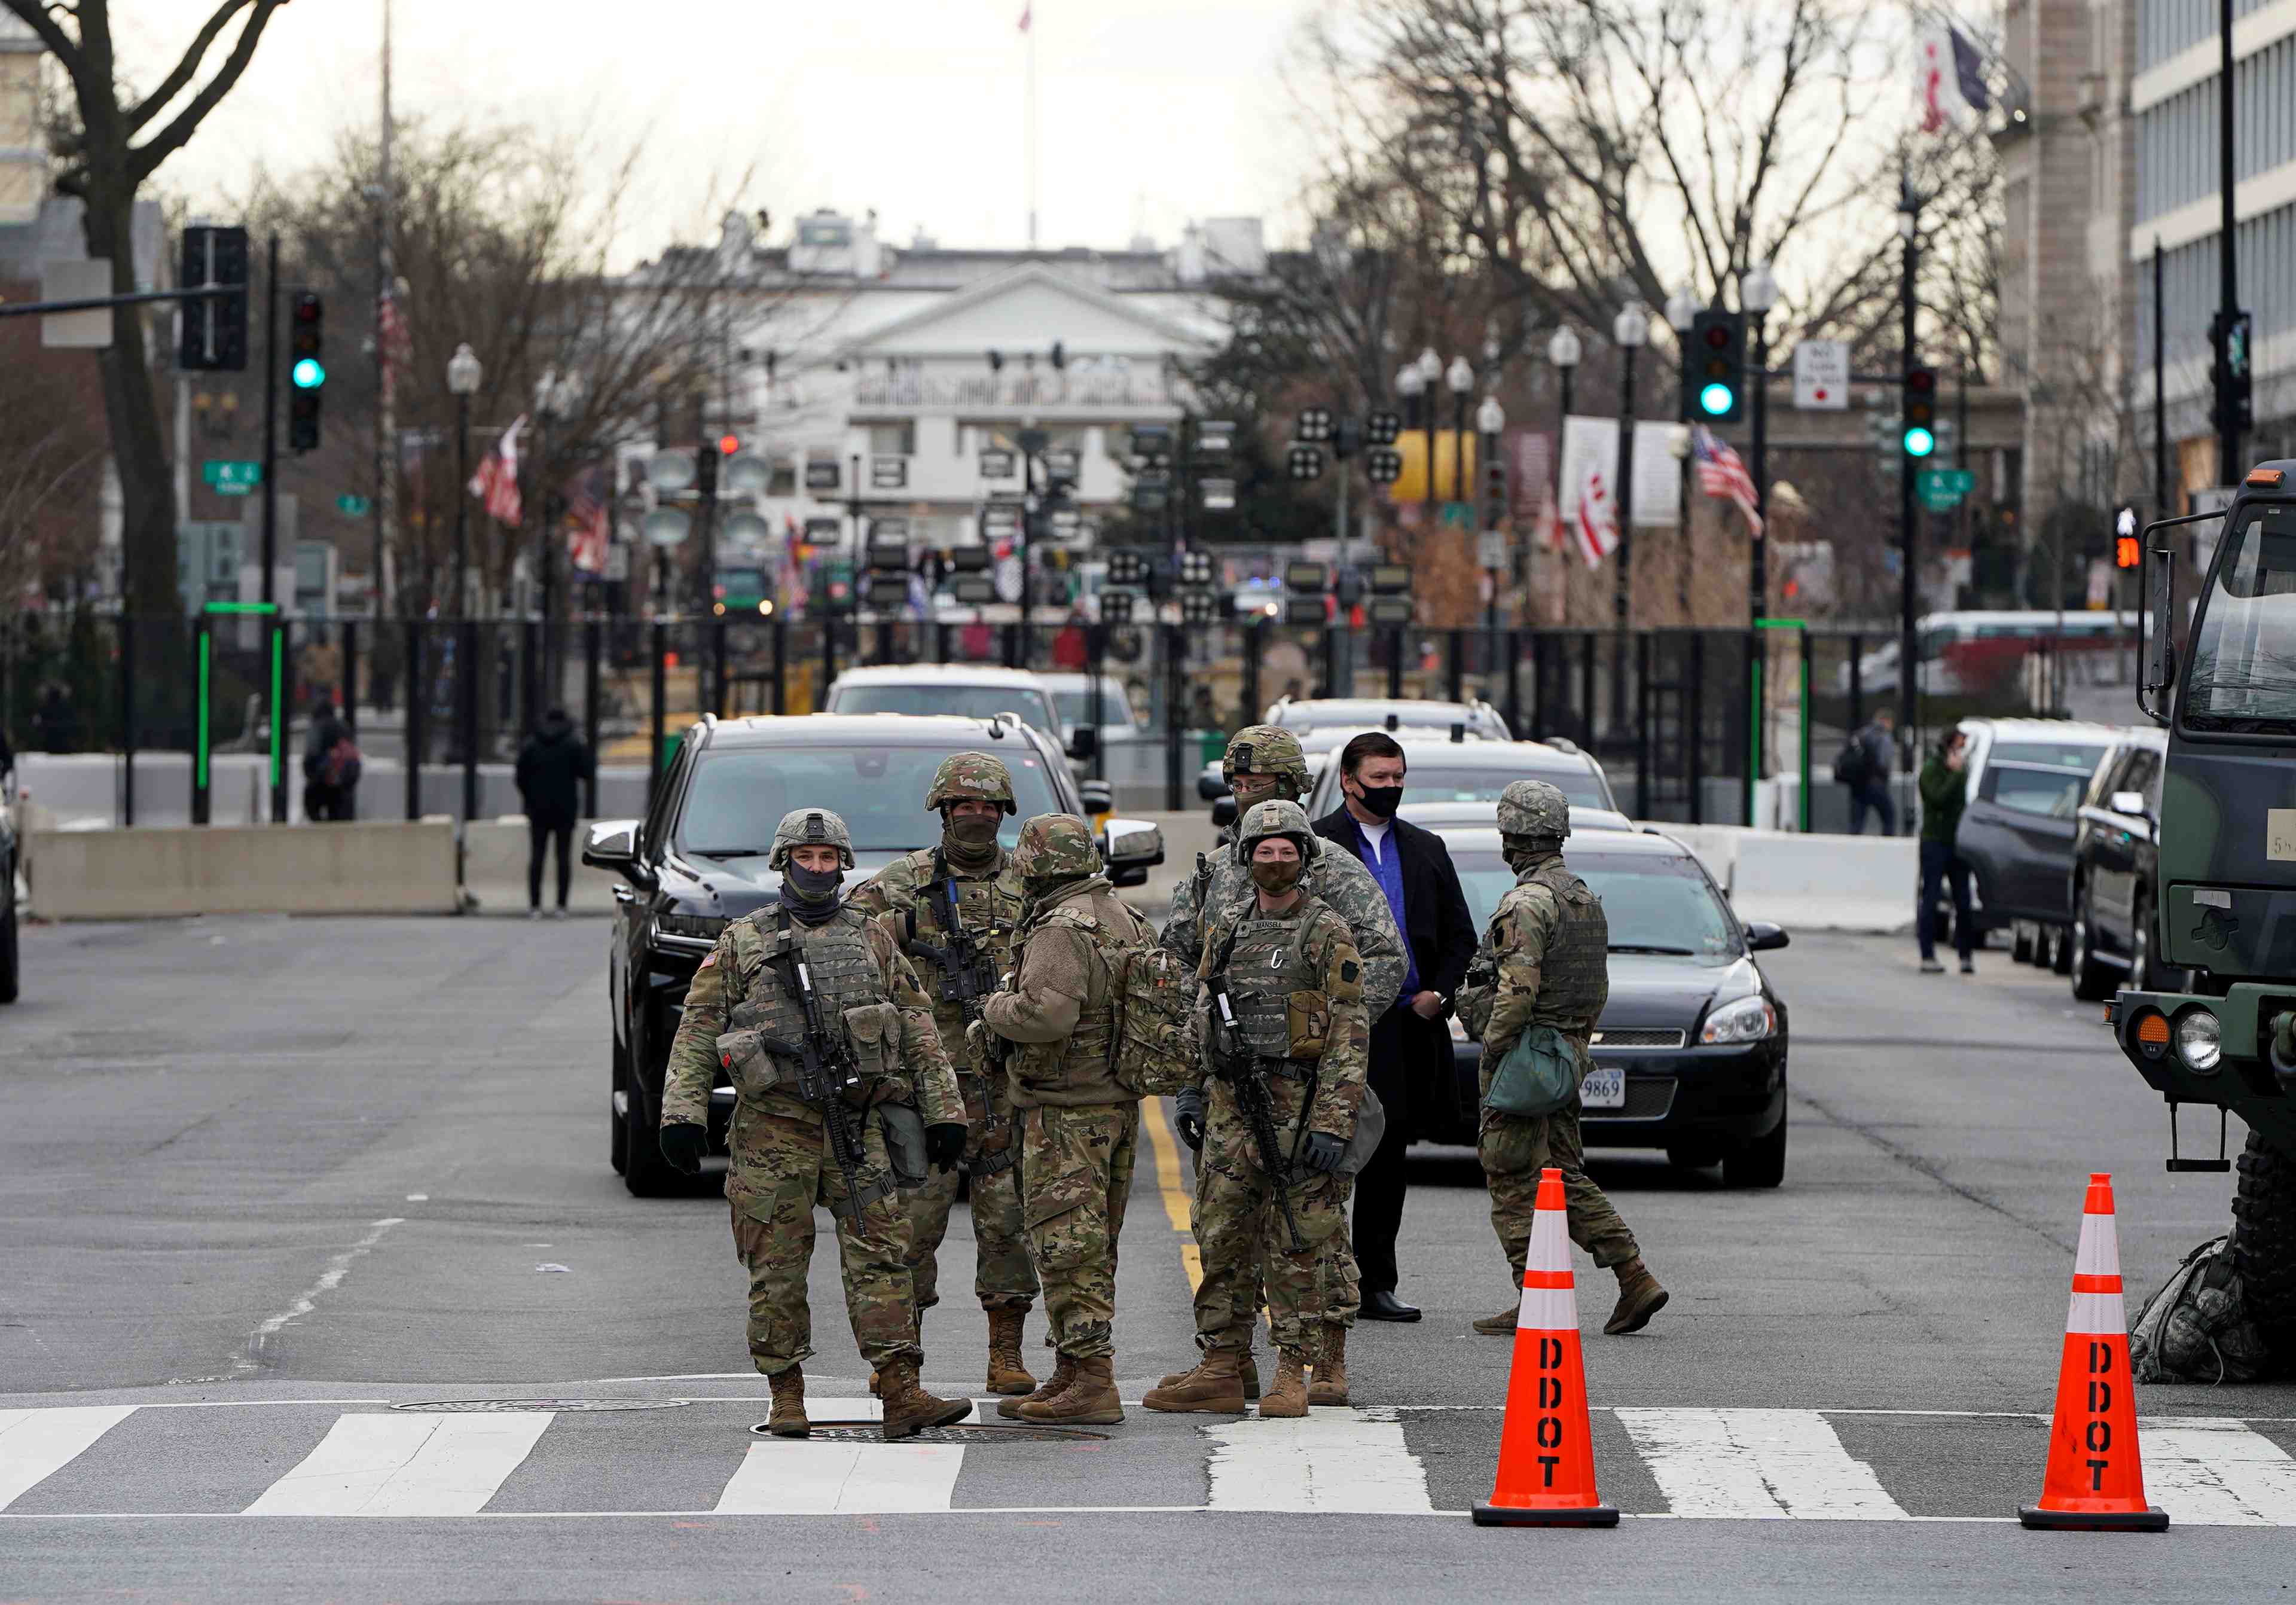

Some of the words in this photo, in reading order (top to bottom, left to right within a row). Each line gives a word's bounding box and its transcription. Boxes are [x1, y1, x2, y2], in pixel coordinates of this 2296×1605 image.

[1584, 1080, 1619, 1097] 9869
[1537, 1338, 1562, 1487] DDOT
[2086, 1342, 2112, 1491] DDOT
